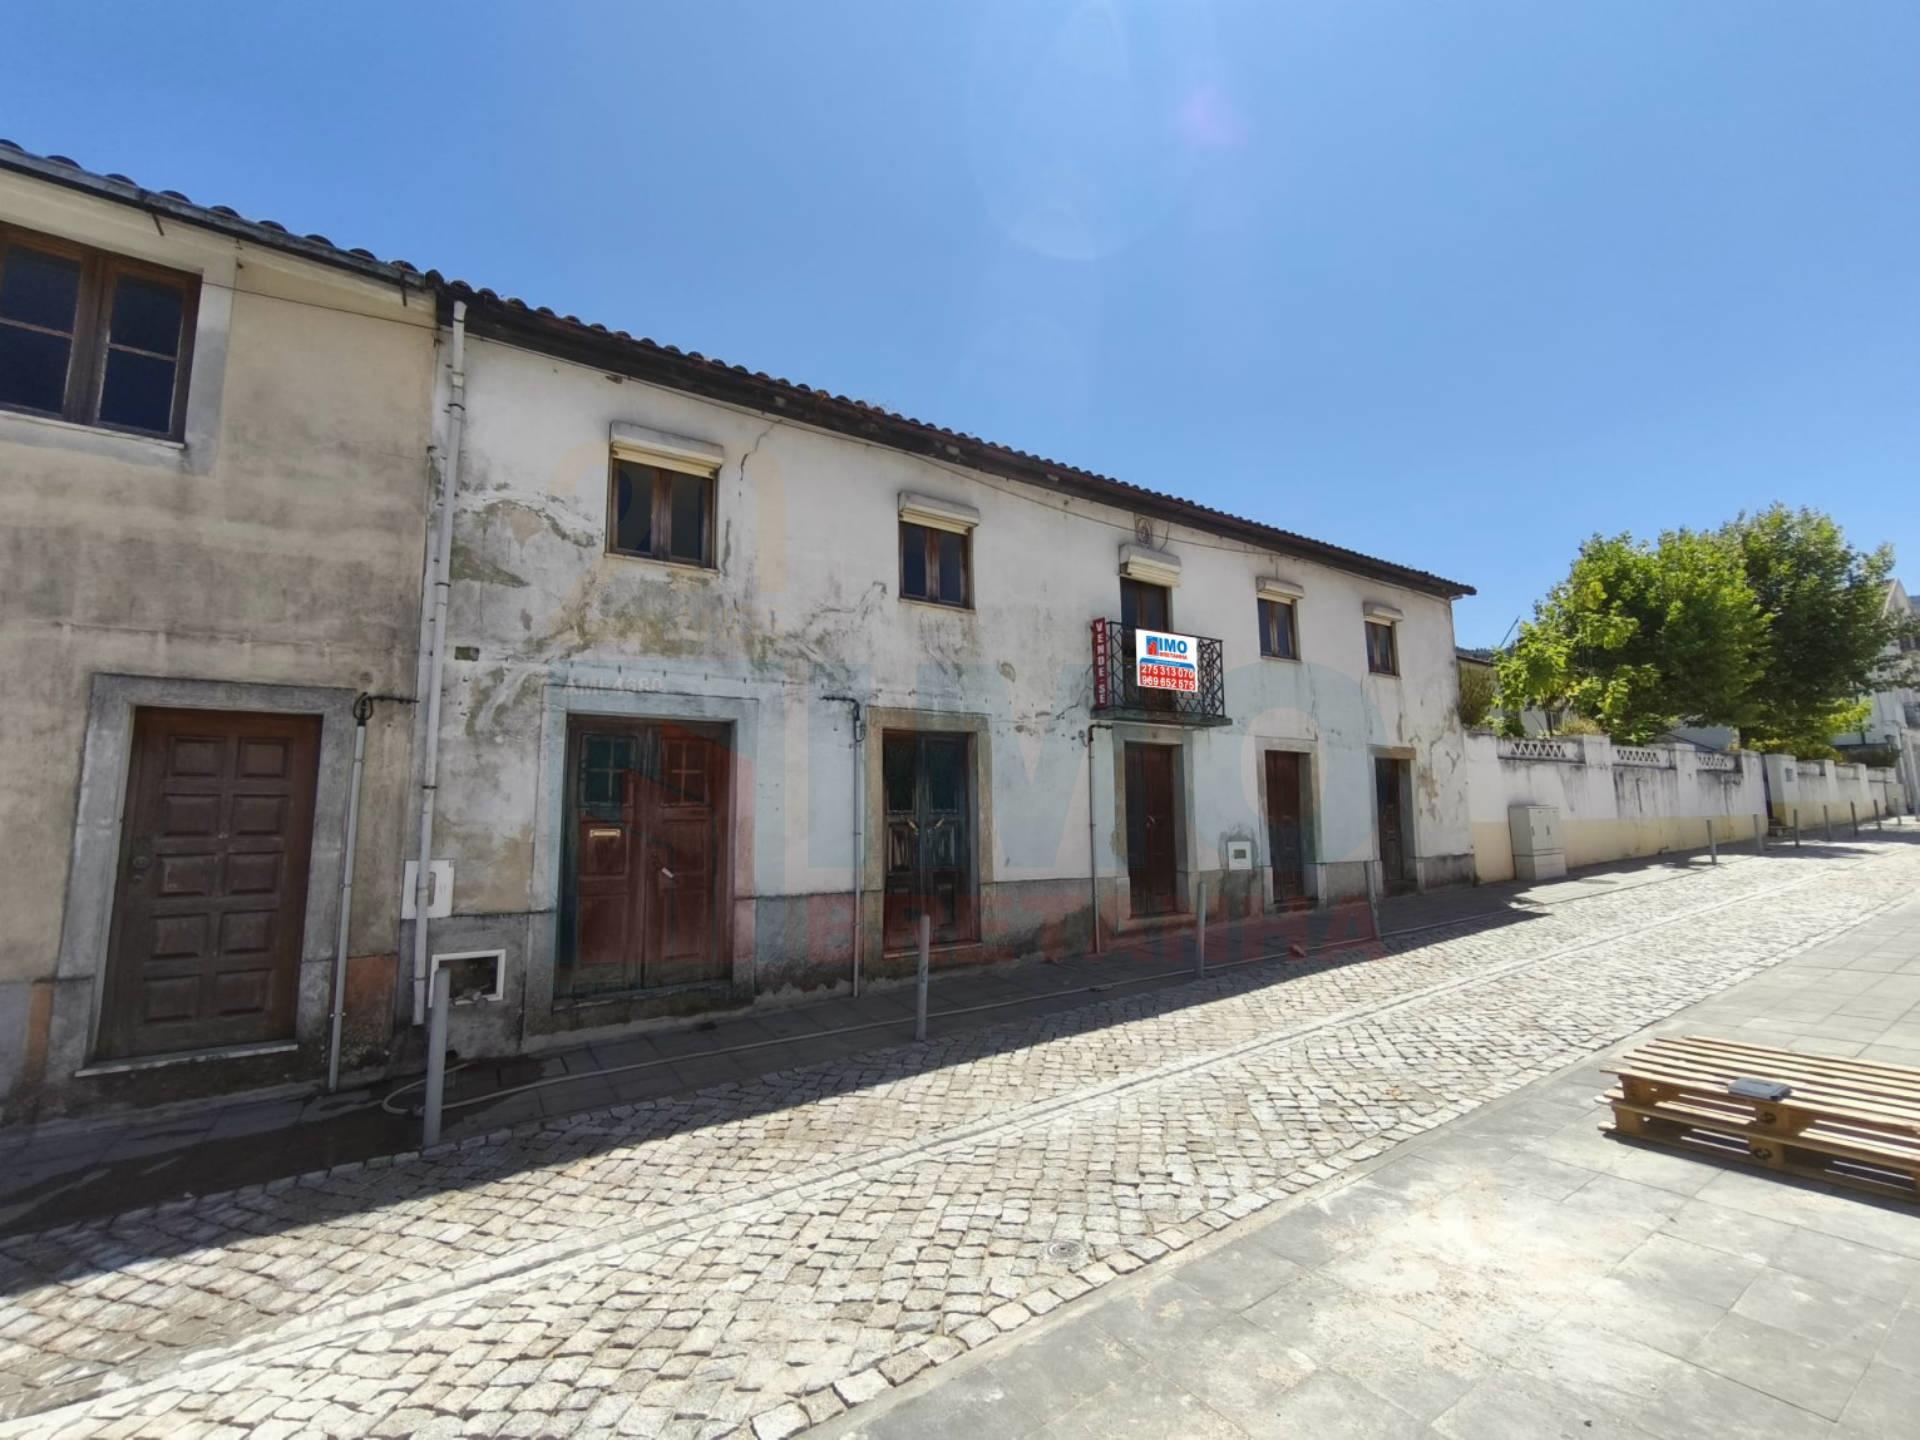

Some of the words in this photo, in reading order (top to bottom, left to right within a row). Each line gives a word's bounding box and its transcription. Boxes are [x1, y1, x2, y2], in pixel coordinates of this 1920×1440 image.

[1159, 638, 1188, 653] IMO
[1141, 664, 1158, 675] 275
[1159, 666, 1177, 677] 313
[1178, 668, 1194, 679] 070
